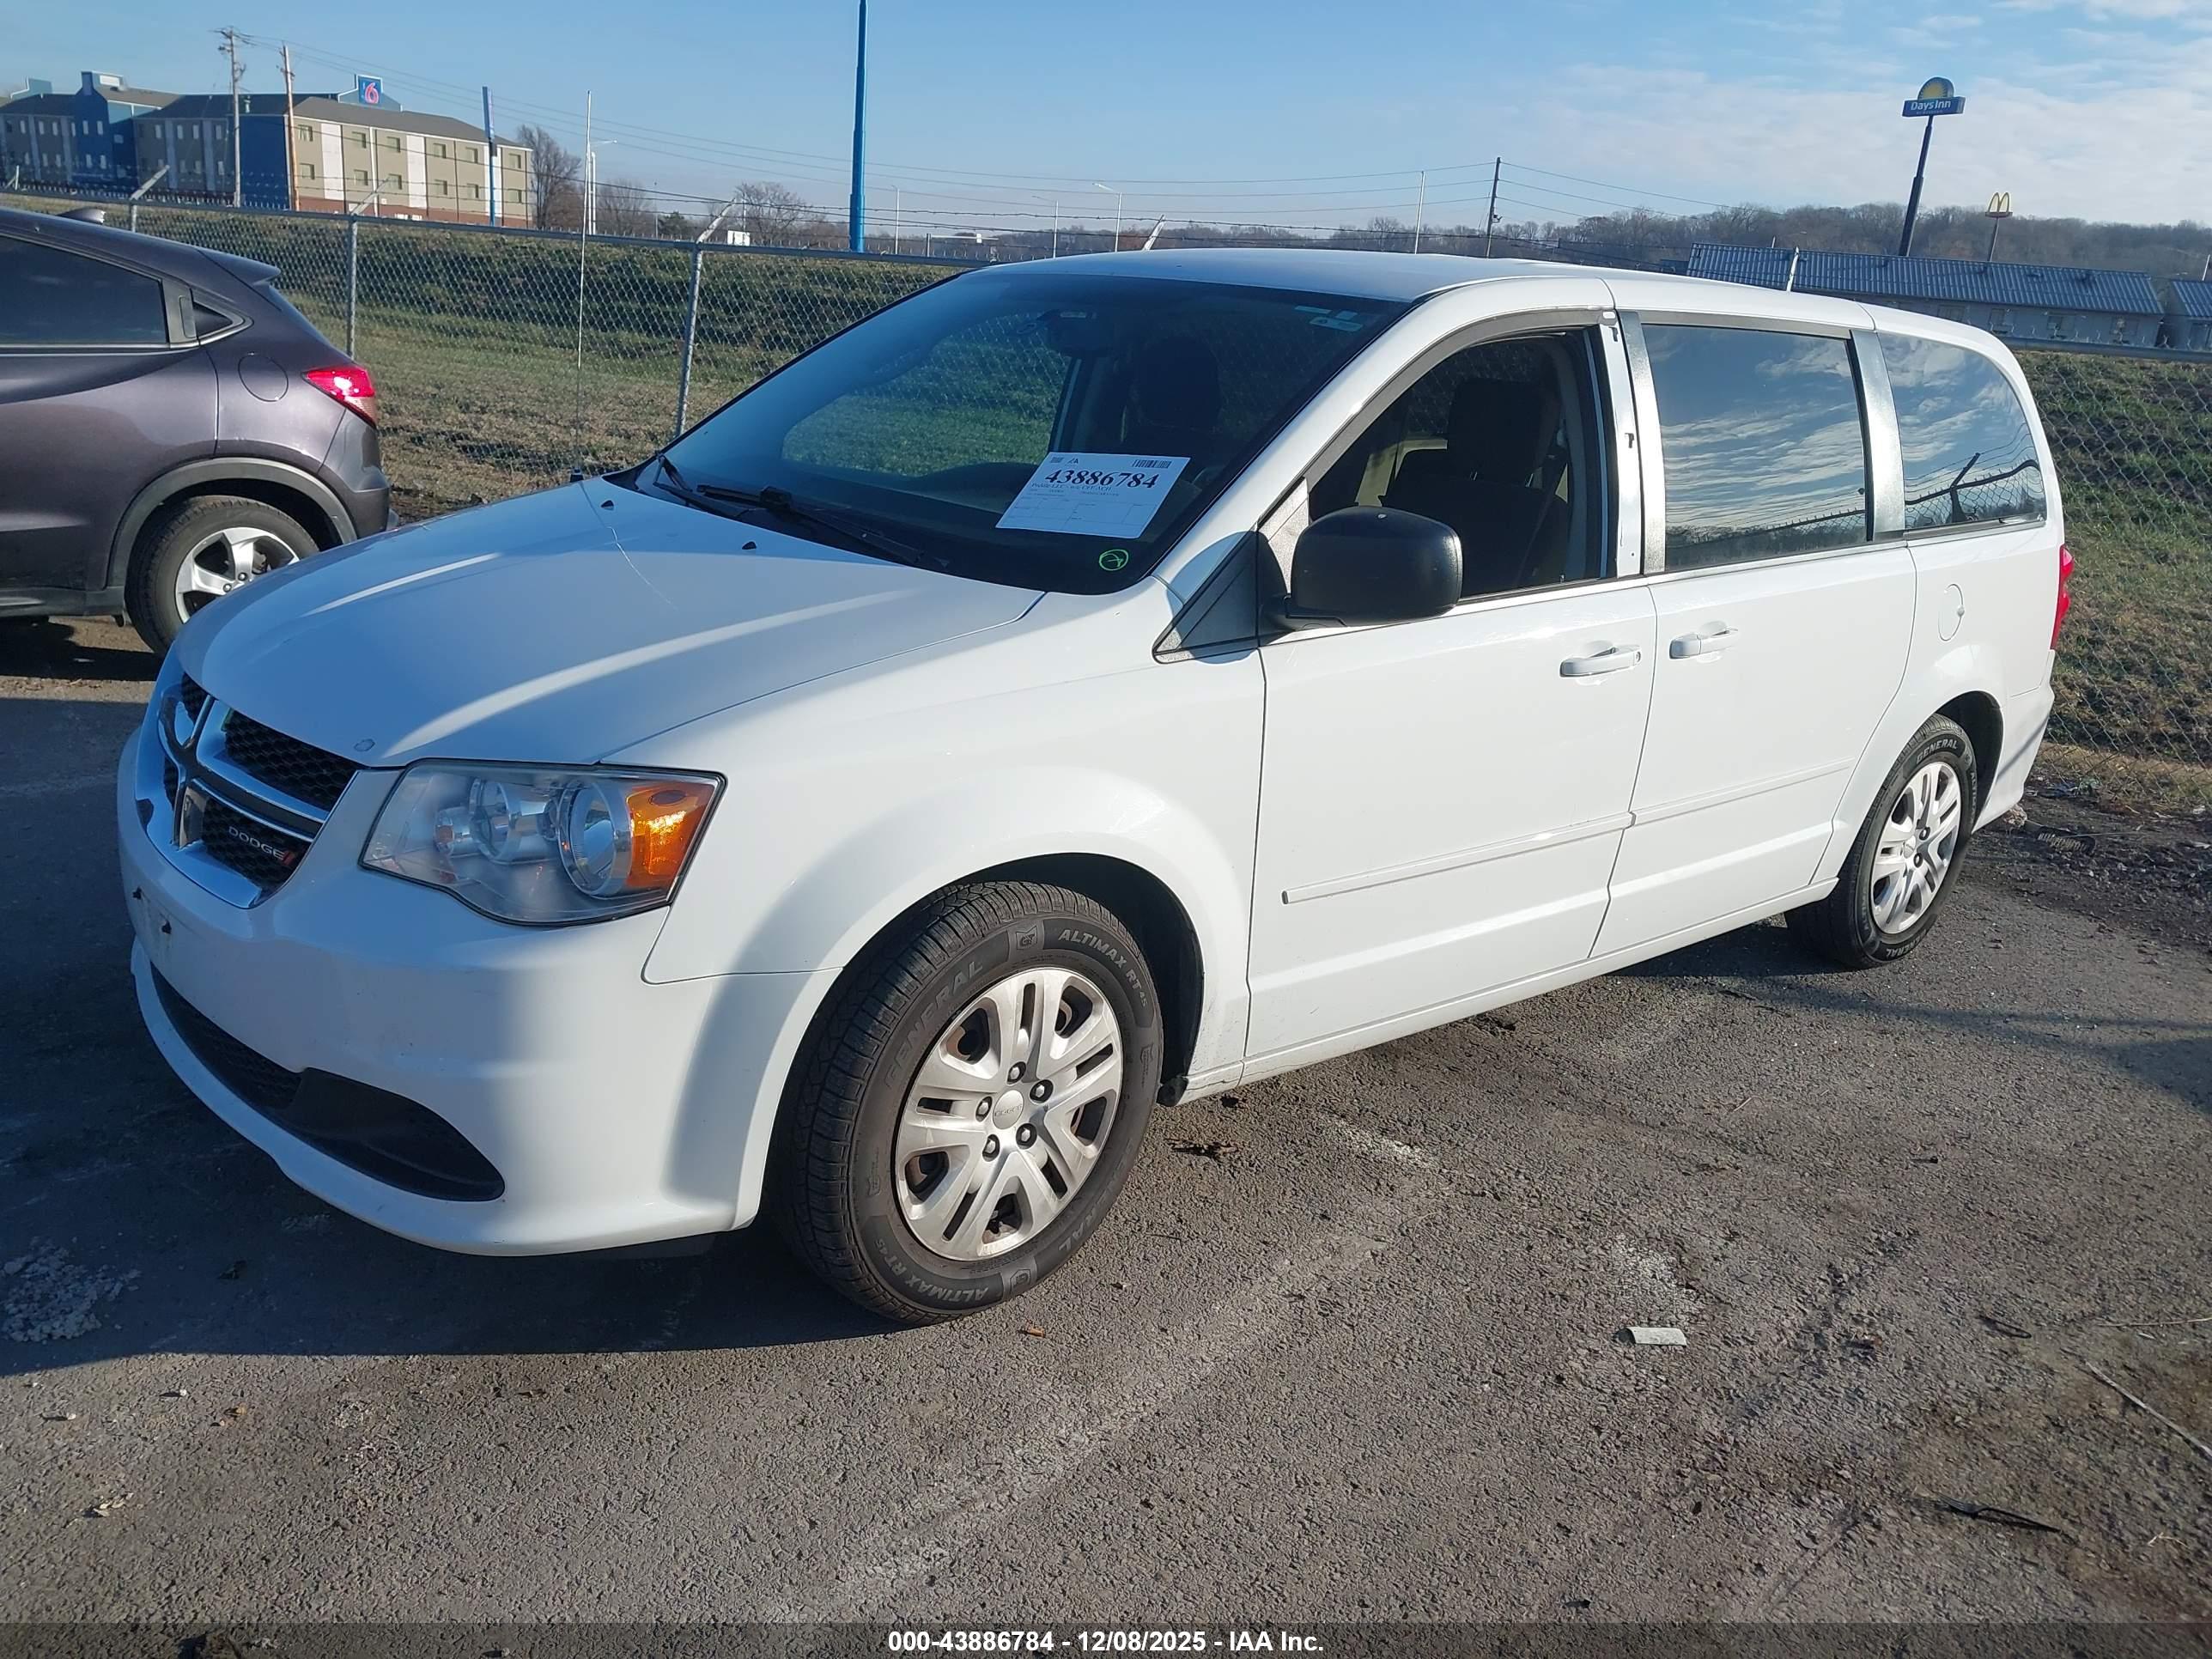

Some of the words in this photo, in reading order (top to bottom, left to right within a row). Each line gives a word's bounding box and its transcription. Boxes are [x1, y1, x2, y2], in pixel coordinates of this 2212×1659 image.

[365, 82, 379, 104] 6
[1911, 101, 1934, 111] Days
[1935, 100, 1951, 109] Inn
[1045, 469, 1159, 489] 43886784
[1917, 738, 1959, 764] GENERAL
[228, 826, 285, 860] DODGE
[1058, 929, 1127, 969] ALTIMAX
[904, 1274, 989, 1303] ALTIMAX
